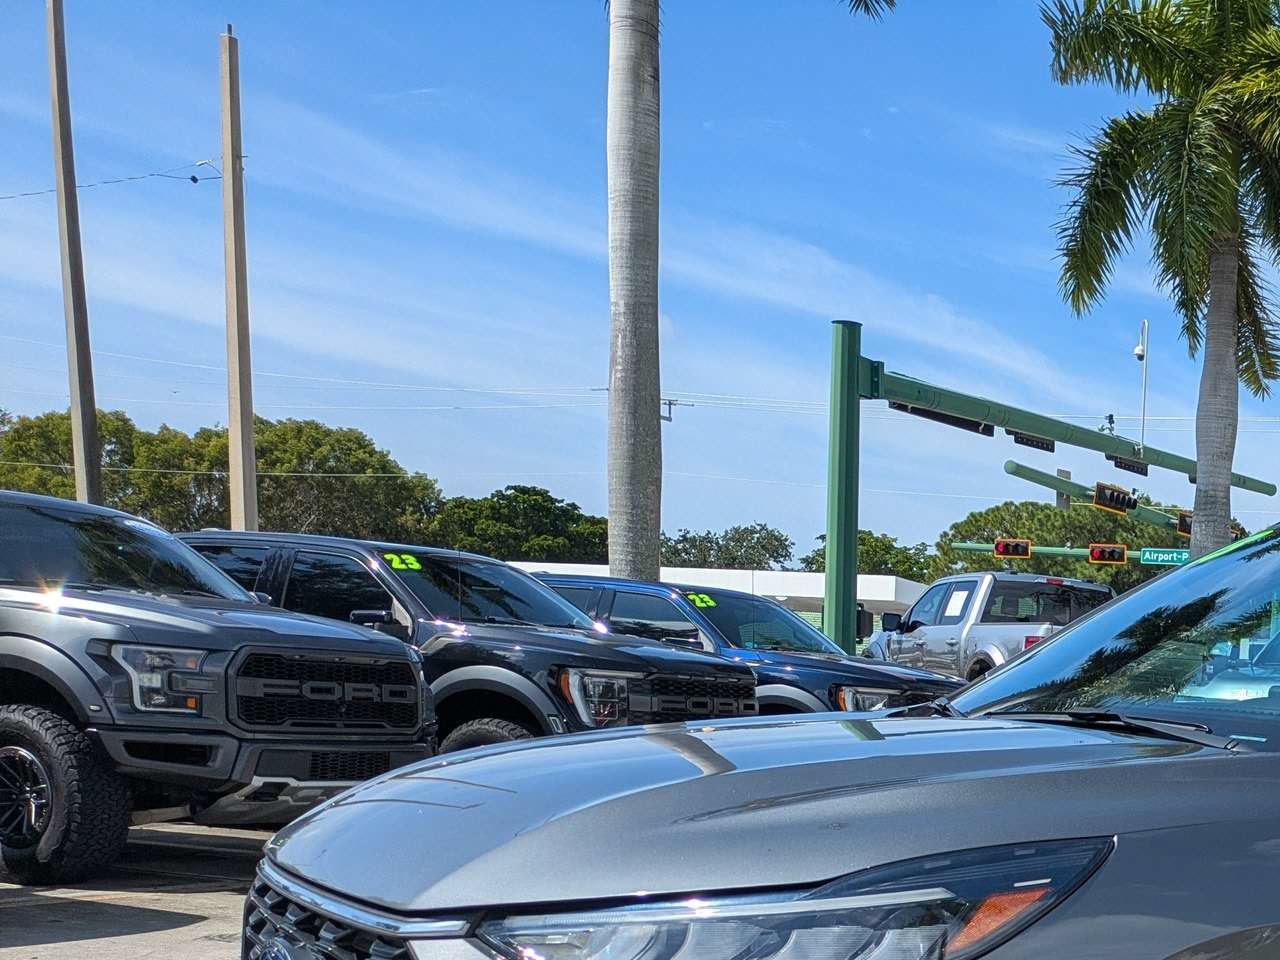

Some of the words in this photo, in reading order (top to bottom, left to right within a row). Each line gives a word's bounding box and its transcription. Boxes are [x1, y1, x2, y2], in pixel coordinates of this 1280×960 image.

[383, 553, 422, 570] 23
[687, 593, 717, 608] 23
[237, 677, 419, 704] FORD
